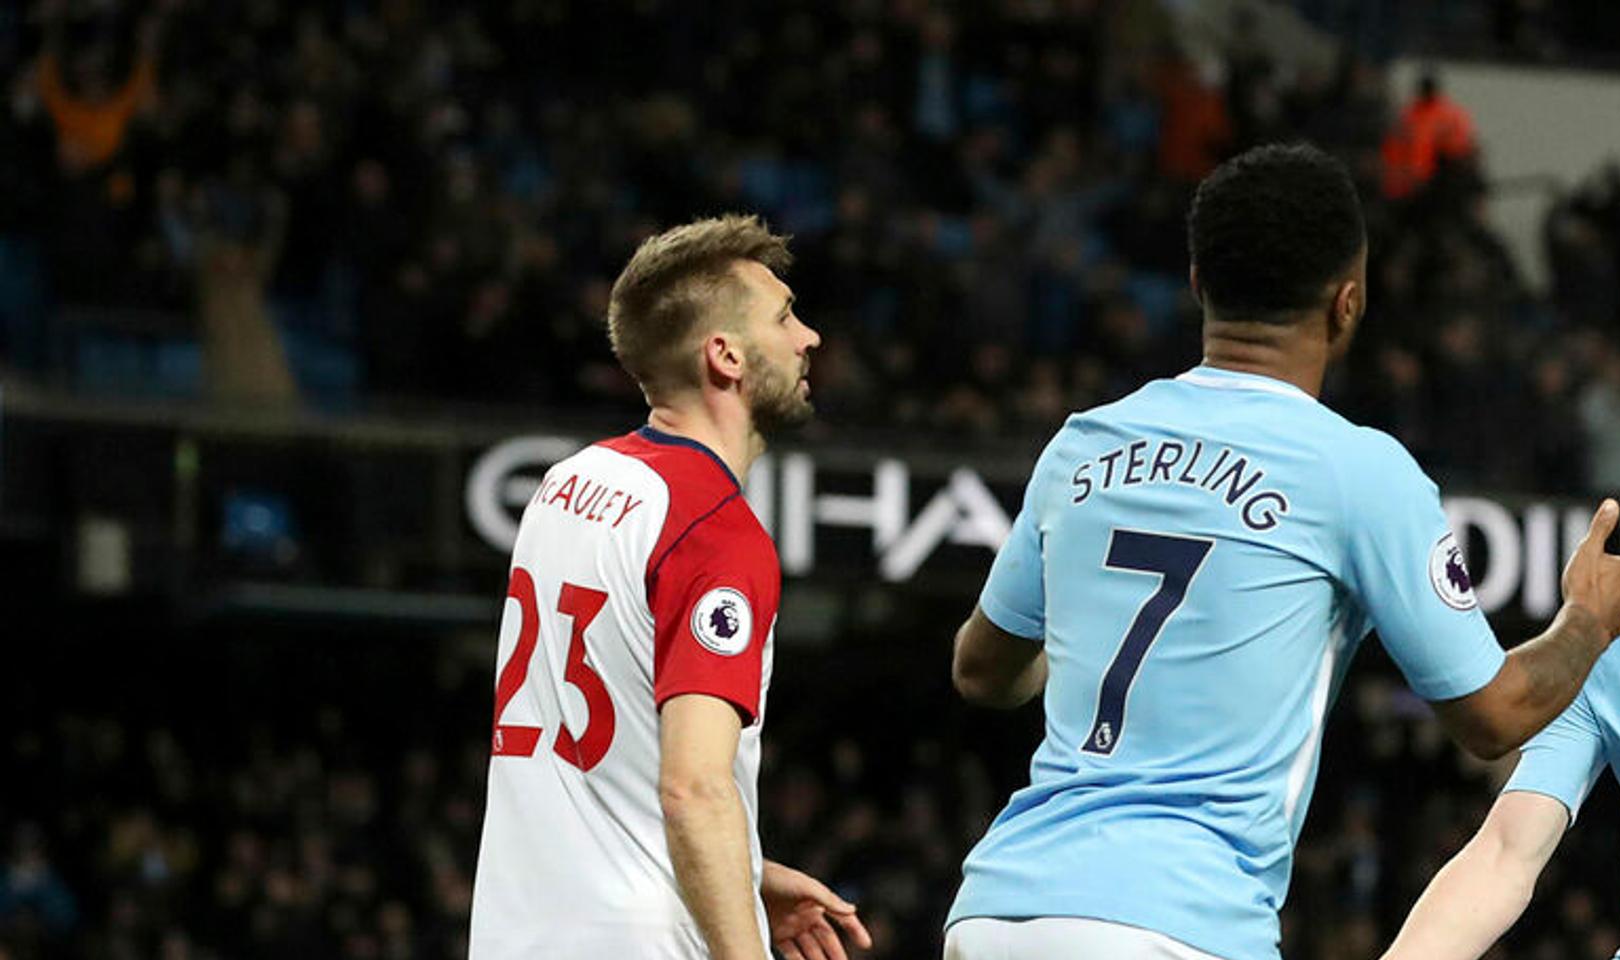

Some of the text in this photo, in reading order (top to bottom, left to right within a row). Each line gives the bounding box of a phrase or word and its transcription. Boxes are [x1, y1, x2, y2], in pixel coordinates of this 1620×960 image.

[1071, 438, 1289, 532] STERLING
[491, 566, 616, 774] 23
[1081, 528, 1216, 758] 7
